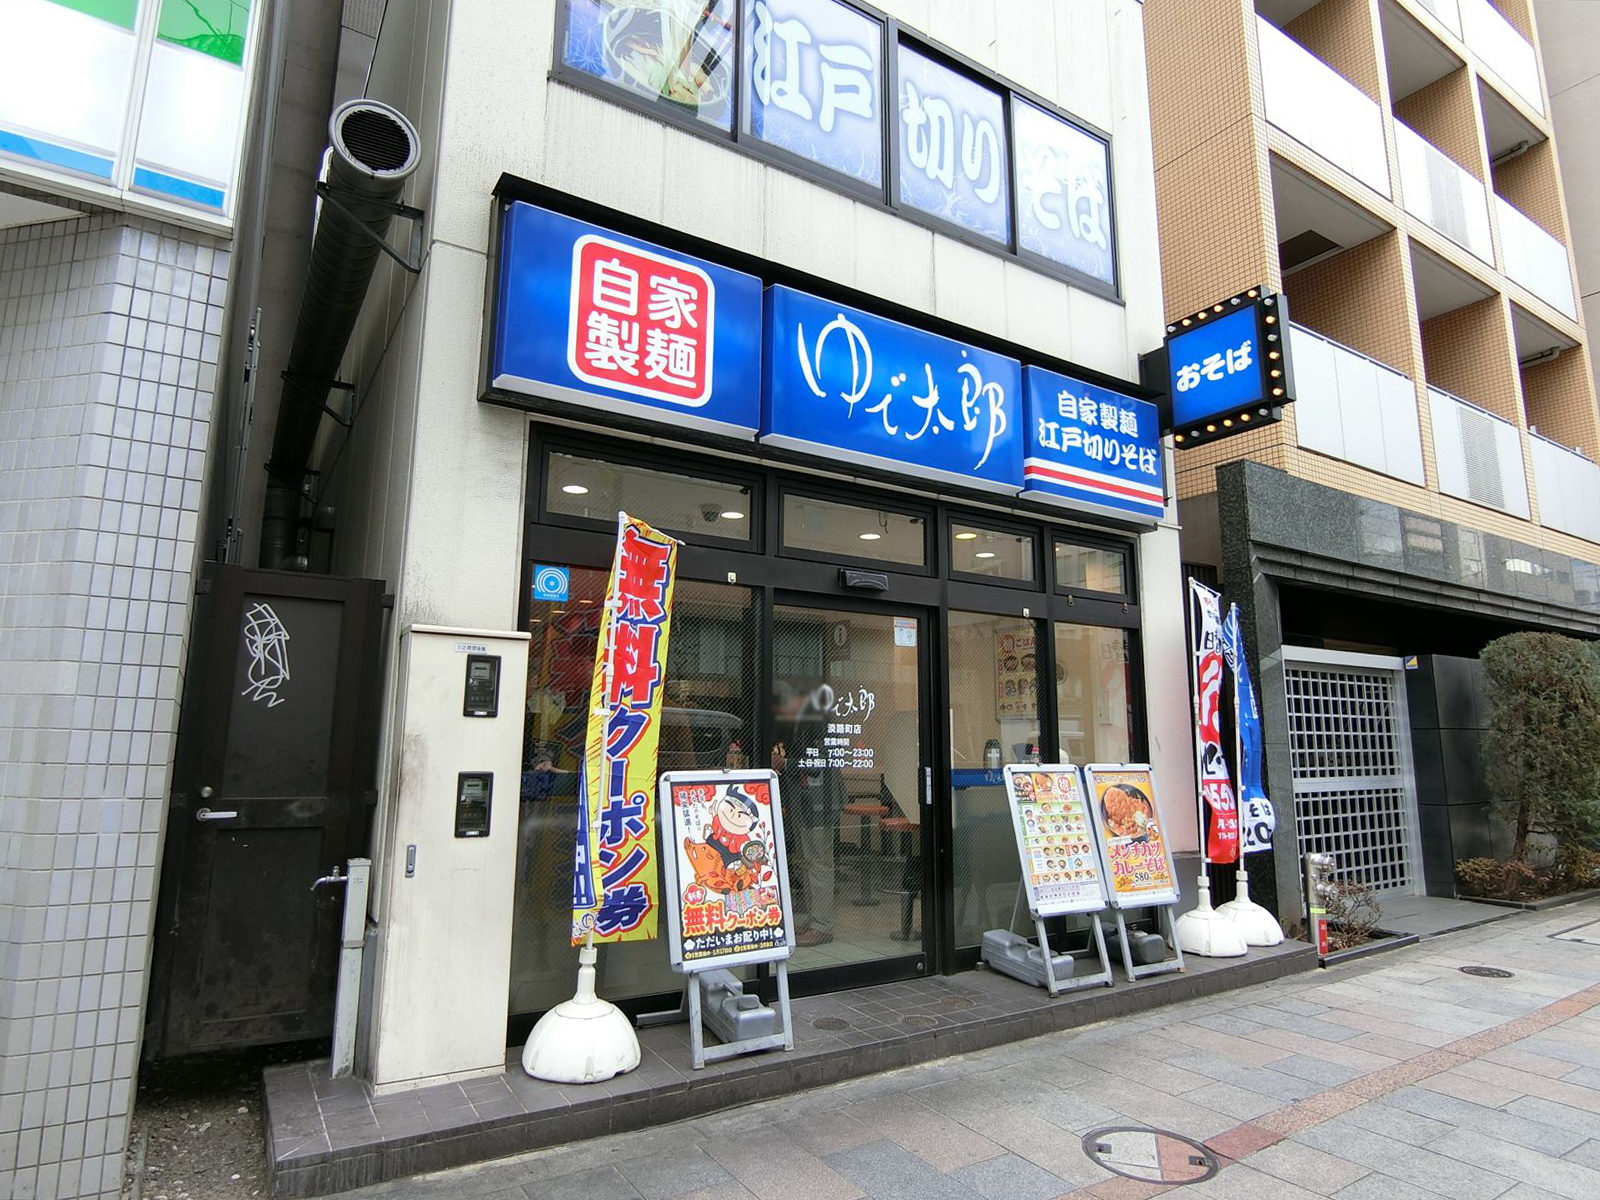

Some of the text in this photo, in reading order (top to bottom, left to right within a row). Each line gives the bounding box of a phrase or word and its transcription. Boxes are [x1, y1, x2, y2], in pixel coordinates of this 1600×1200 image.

[591, 256, 700, 331] 自家
[584, 311, 699, 389] 製麺
[1176, 340, 1252, 392] おそば
[797, 313, 1007, 471] ゆで太郎
[1057, 390, 1138, 438] 自家製麺
[1038, 418, 1157, 475] 江戸切りそば
[824, 737, 850, 747] 営業時間
[827, 723, 862, 734] 淡路町店
[806, 747, 819, 757] 平日
[1110, 842, 1160, 859] メンチカツ
[1113, 856, 1166, 877] カレーそば
[683, 901, 781, 935] 無料クーポン券
